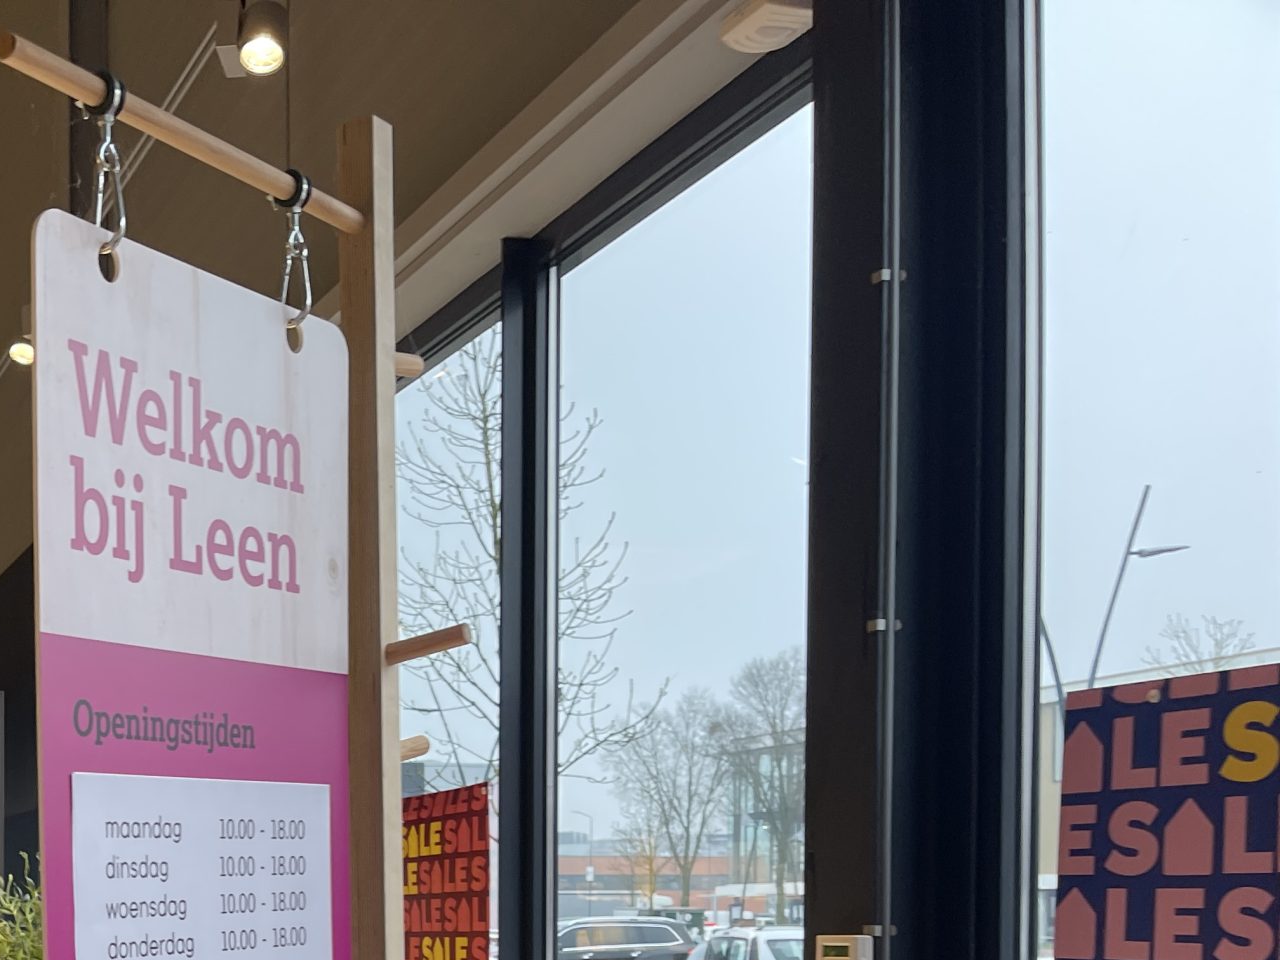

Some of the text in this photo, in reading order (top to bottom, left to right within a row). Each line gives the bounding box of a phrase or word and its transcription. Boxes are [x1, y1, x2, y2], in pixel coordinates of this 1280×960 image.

[68, 338, 304, 494] Welkom
[69, 454, 300, 594] bij Leen
[73, 699, 256, 753] Openingstijden
[105, 816, 182, 843] maandag
[219, 819, 255, 840] 10.00
[270, 819, 306, 840] 18.00
[106, 855, 169, 882] dinsdag
[220, 856, 255, 877] 10.00
[271, 856, 306, 876] 18.00
[106, 894, 187, 920] woensdag
[220, 893, 256, 914] 10.00
[271, 891, 306, 912] 18.00
[108, 932, 195, 959] donderdag
[221, 929, 257, 951] 10.00
[272, 926, 307, 948] 18.00
